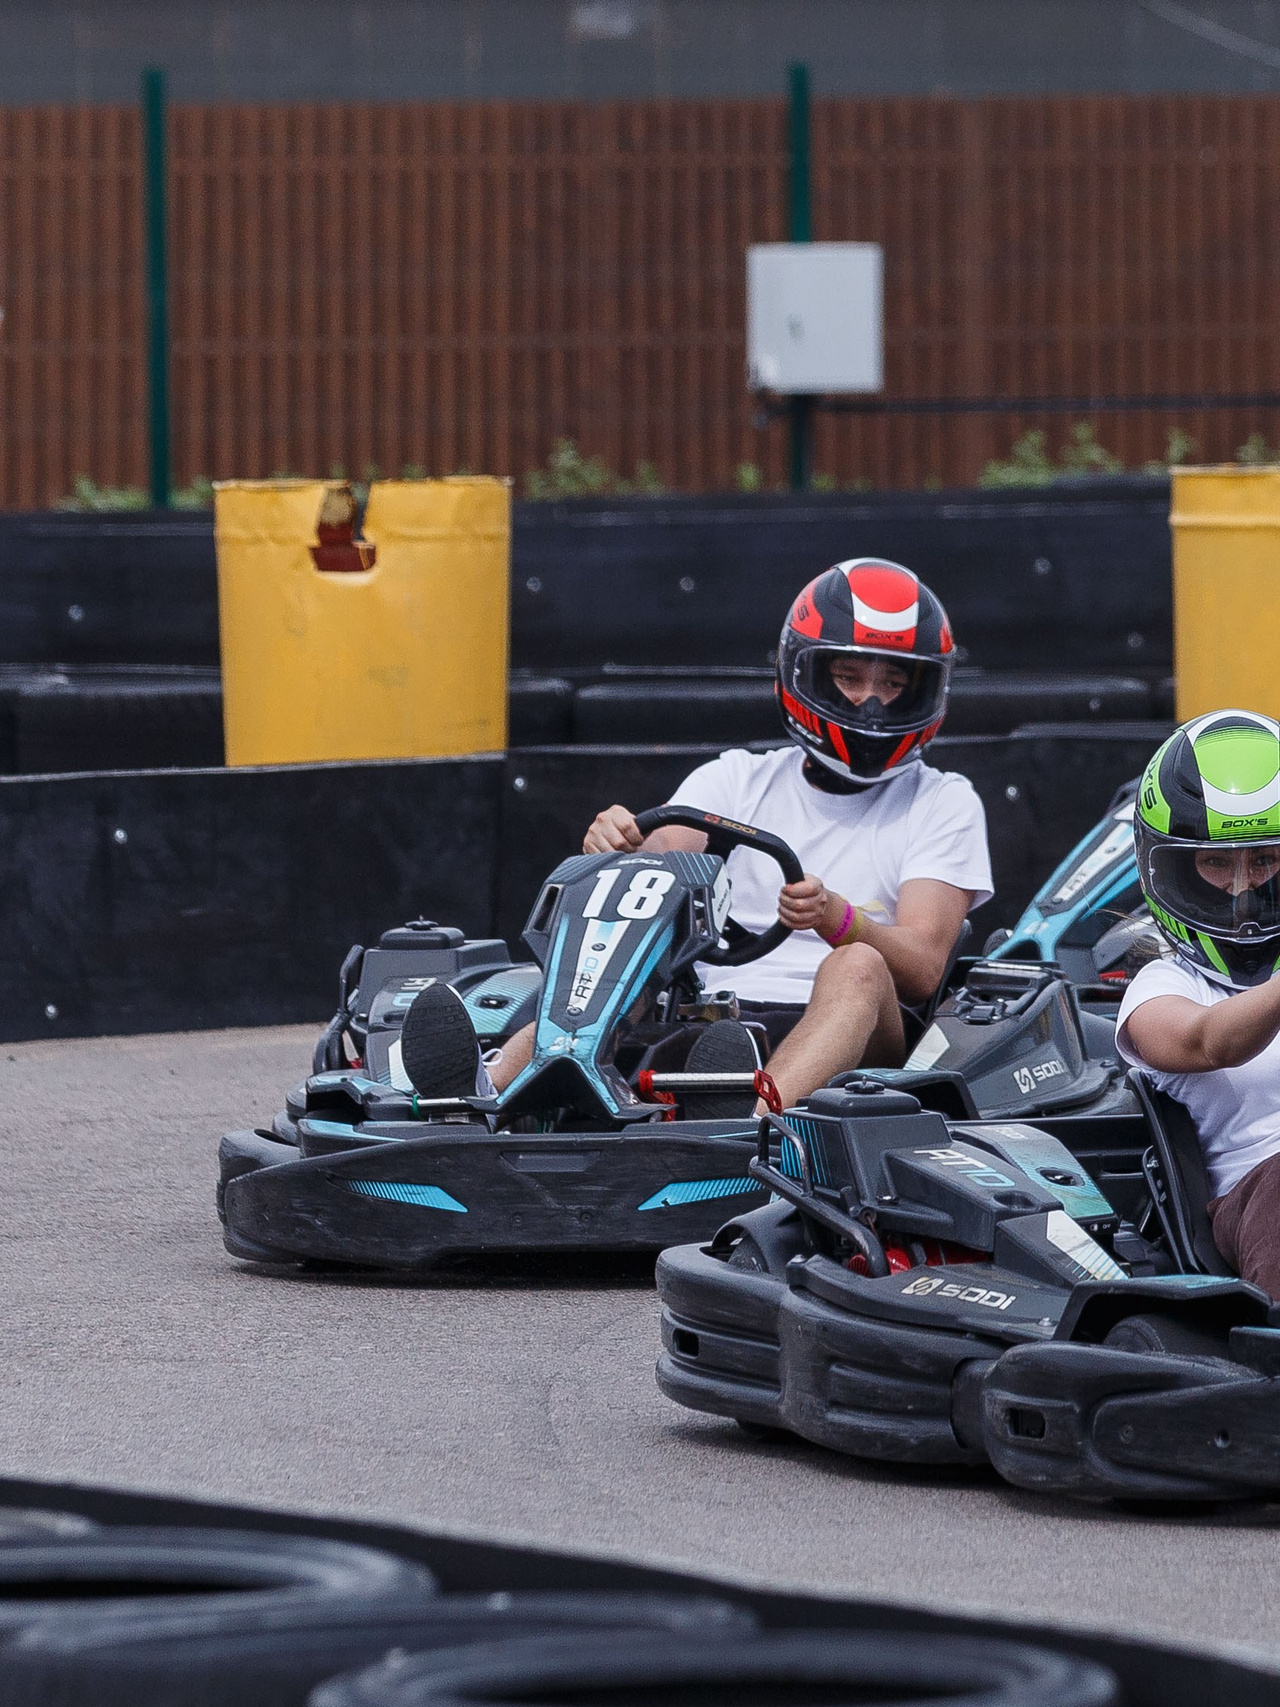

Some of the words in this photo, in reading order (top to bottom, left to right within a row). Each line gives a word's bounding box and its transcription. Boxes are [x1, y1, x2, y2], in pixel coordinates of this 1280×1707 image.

[721, 819, 757, 835] SODI
[1220, 818, 1268, 828] BOX'S
[582, 869, 676, 919] 18
[575, 956, 599, 999] RT10
[1033, 1060, 1065, 1082] SODI
[913, 1149, 1016, 1187] RT10
[936, 1283, 1016, 1310] SODI
